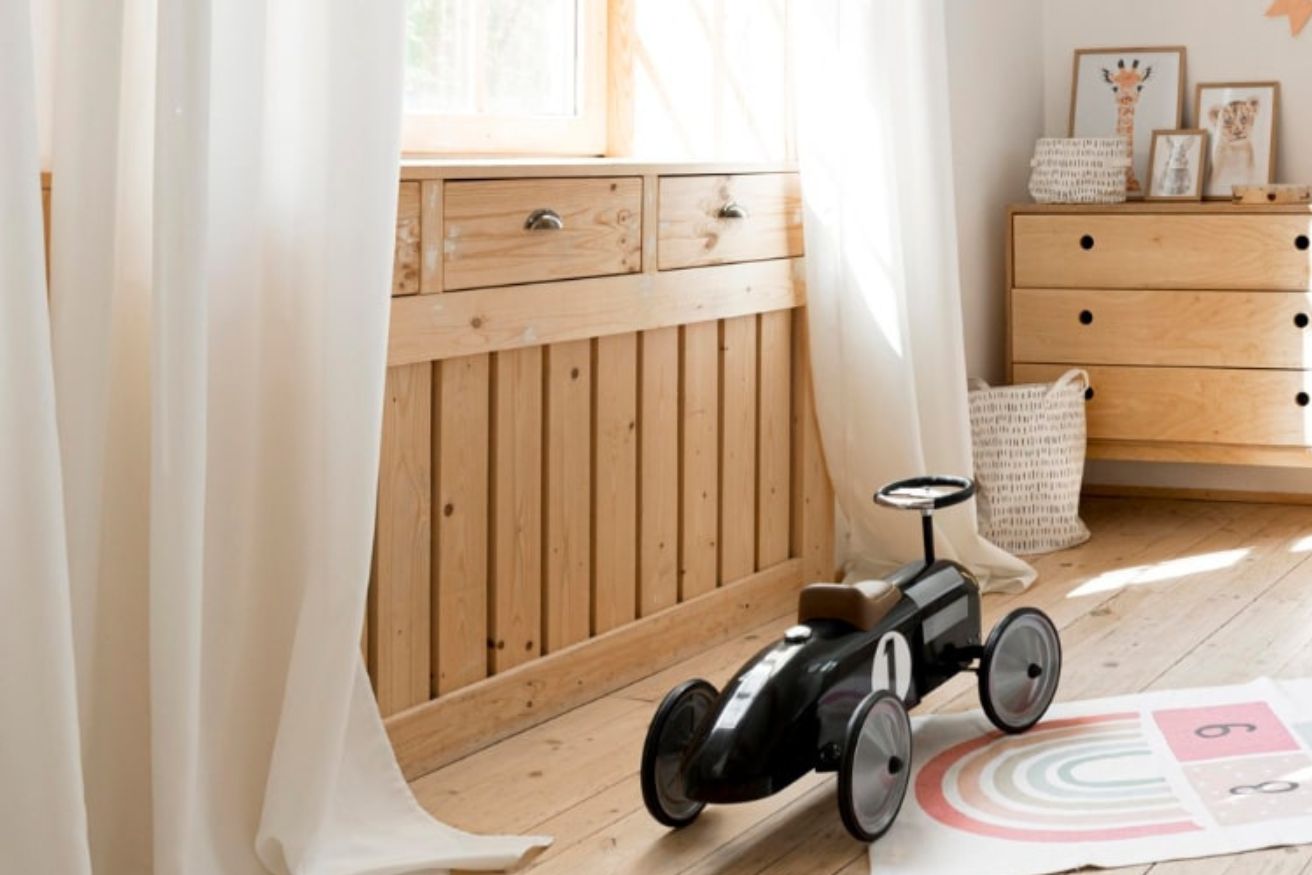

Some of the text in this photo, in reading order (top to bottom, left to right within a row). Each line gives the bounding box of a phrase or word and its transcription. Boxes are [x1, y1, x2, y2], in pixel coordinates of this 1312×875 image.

[884, 638, 897, 693] 1
[1194, 722, 1258, 739] 9
[1228, 780, 1300, 795] 8
